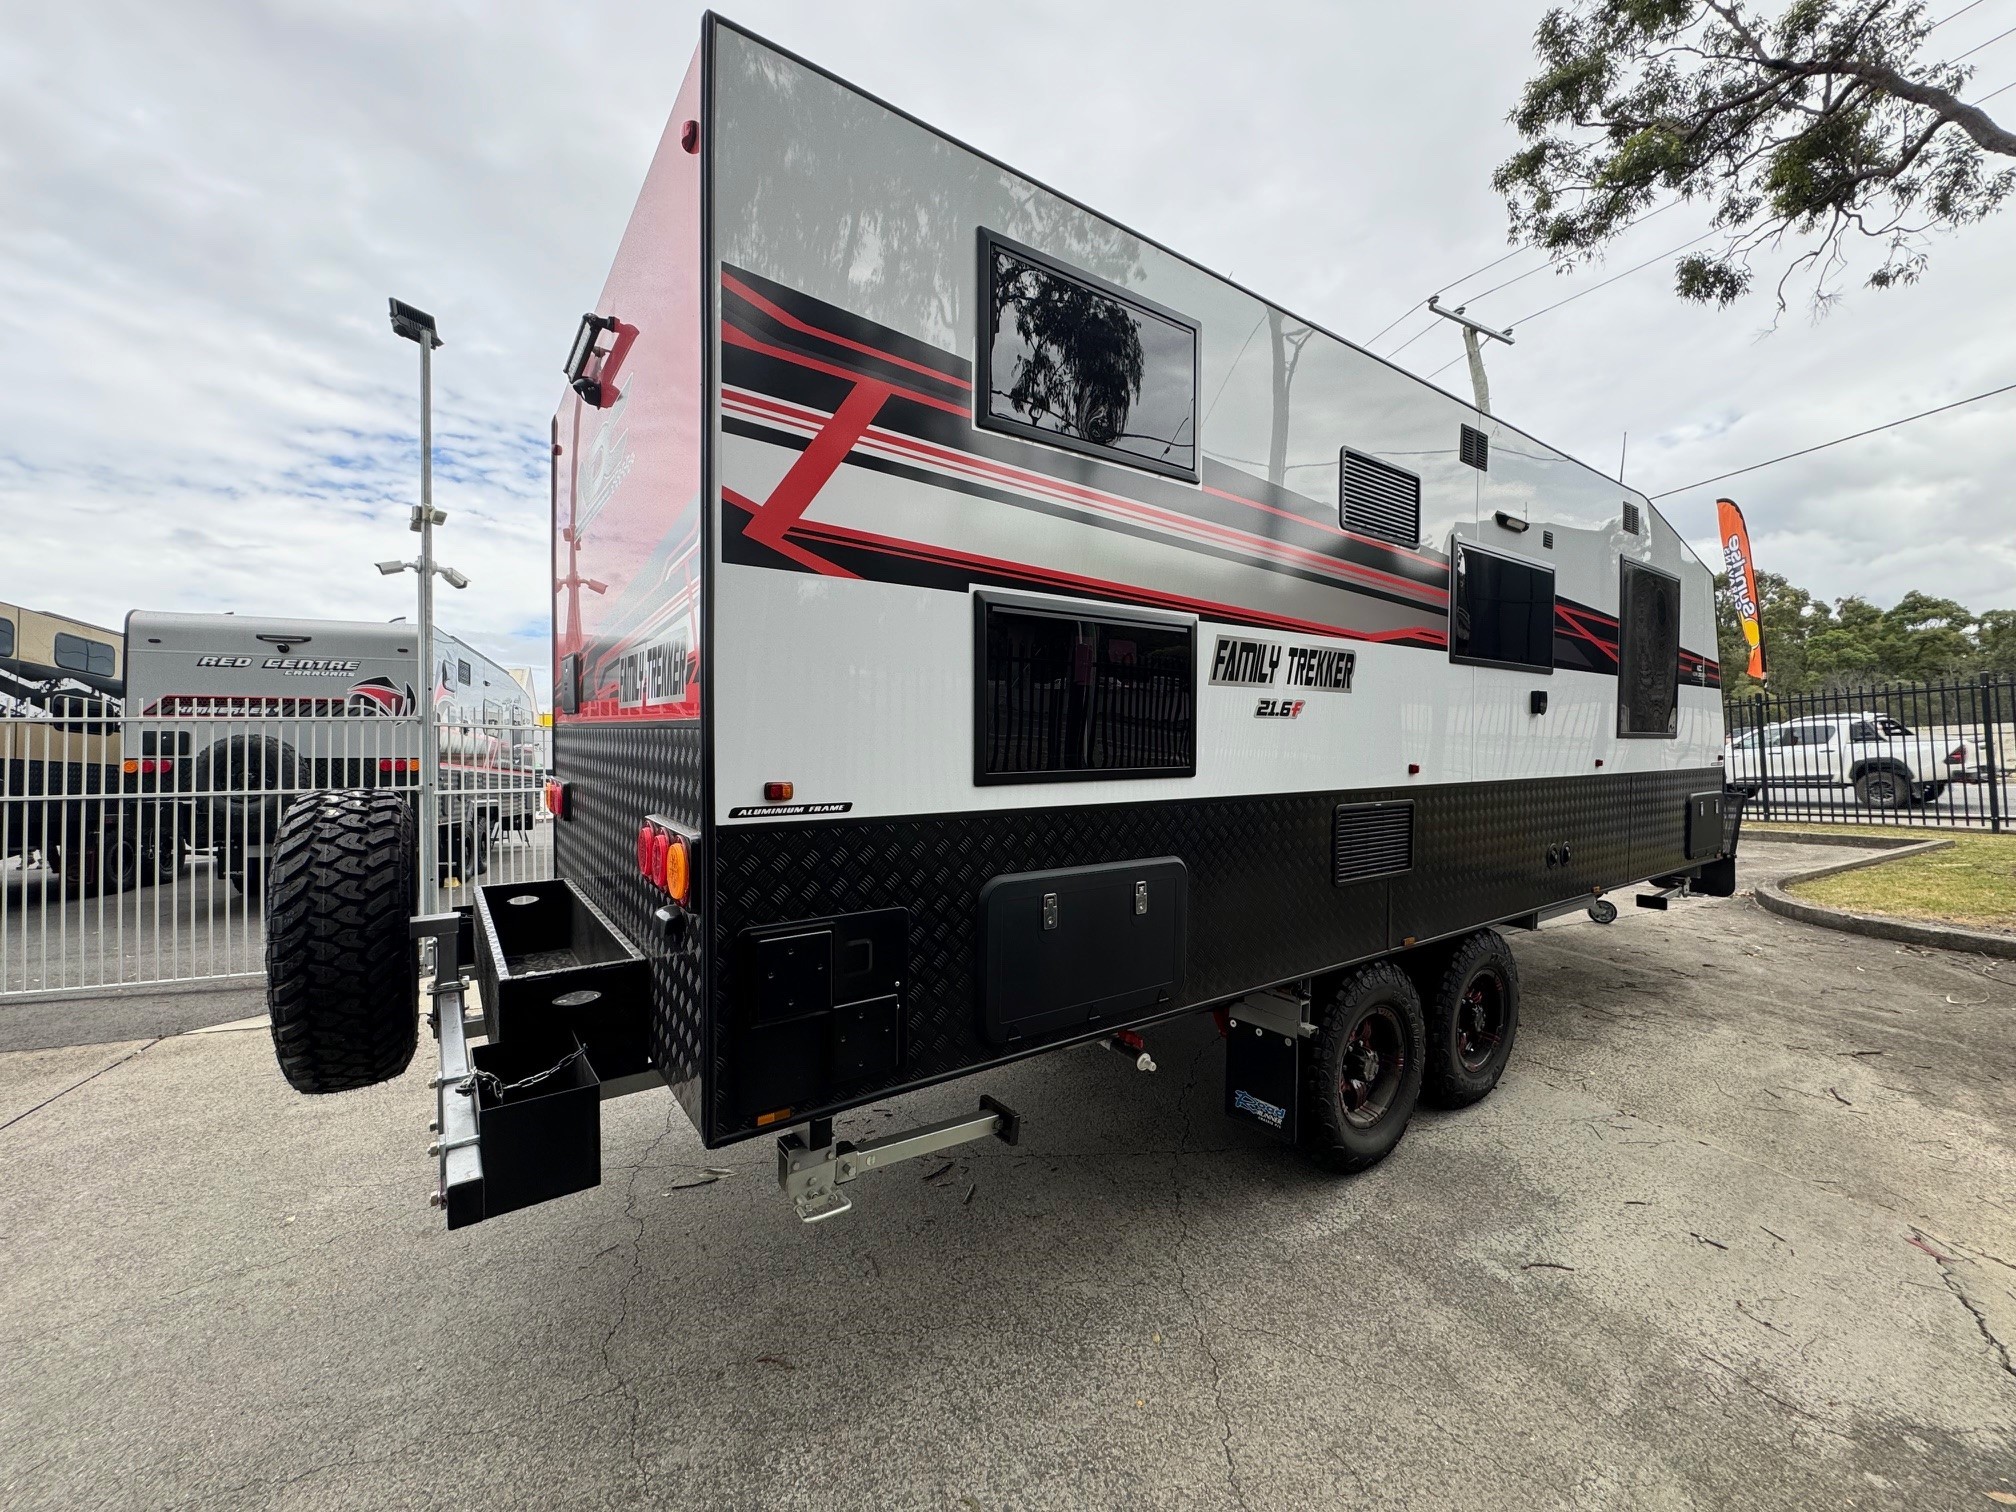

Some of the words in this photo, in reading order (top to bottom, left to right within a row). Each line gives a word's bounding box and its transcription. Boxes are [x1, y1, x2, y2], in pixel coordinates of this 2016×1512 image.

[197, 656, 253, 668] RED
[262, 658, 361, 671] CENTRE
[619, 650, 645, 703] FAMILY
[647, 636, 686, 699] TREKKER
[1212, 639, 1282, 684] FAMILY
[1286, 647, 1355, 689] TREKKER
[1256, 700, 1304, 717] 21.6F
[738, 806, 805, 816] ALUMINIUM
[808, 804, 845, 813] FRAME
